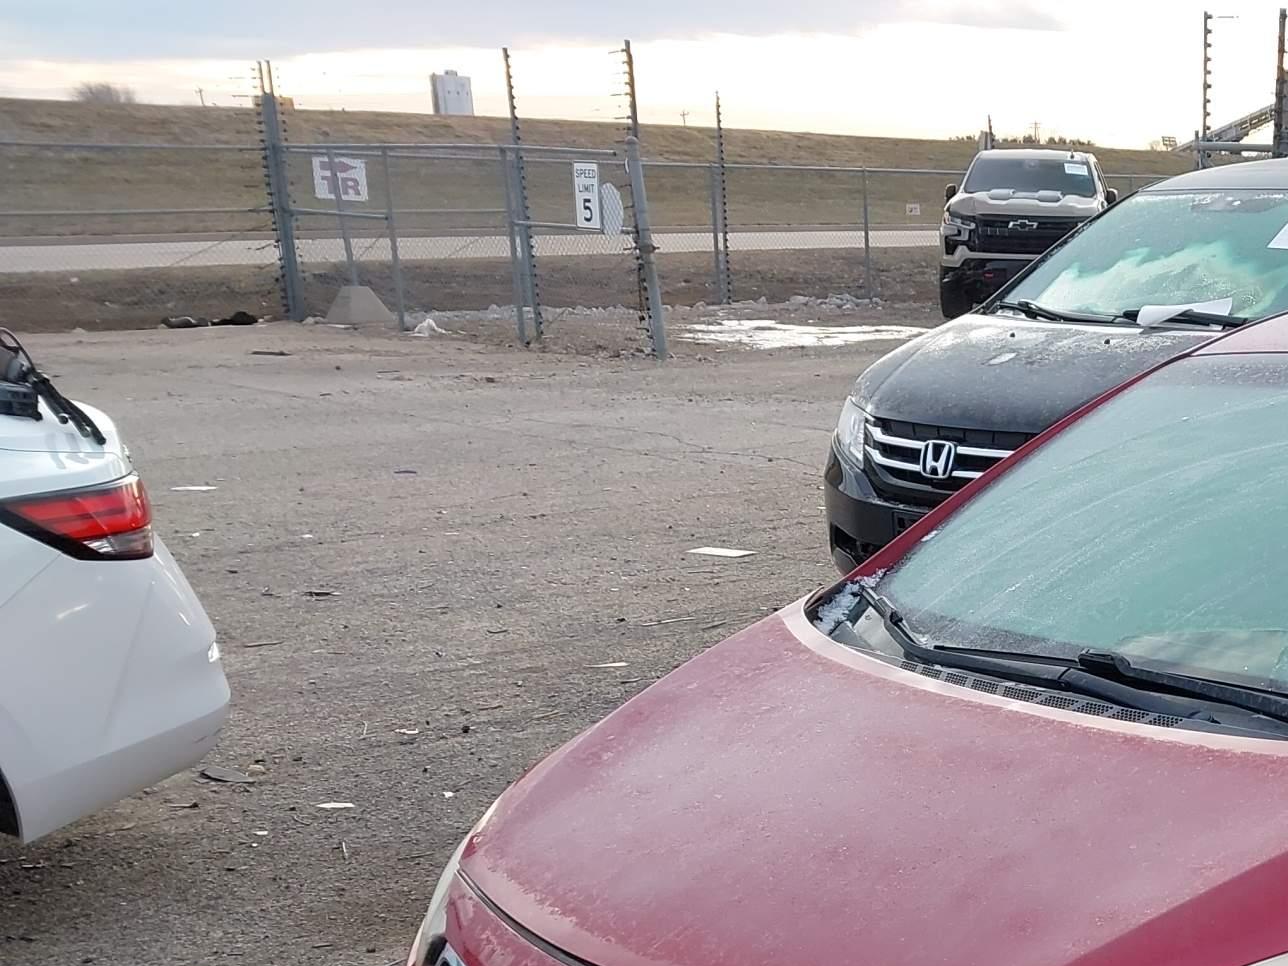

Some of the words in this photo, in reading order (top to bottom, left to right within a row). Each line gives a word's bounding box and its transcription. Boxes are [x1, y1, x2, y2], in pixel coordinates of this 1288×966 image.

[575, 168, 596, 179] SPEED
[577, 183, 595, 193] LIMIT
[583, 198, 593, 223] 5
